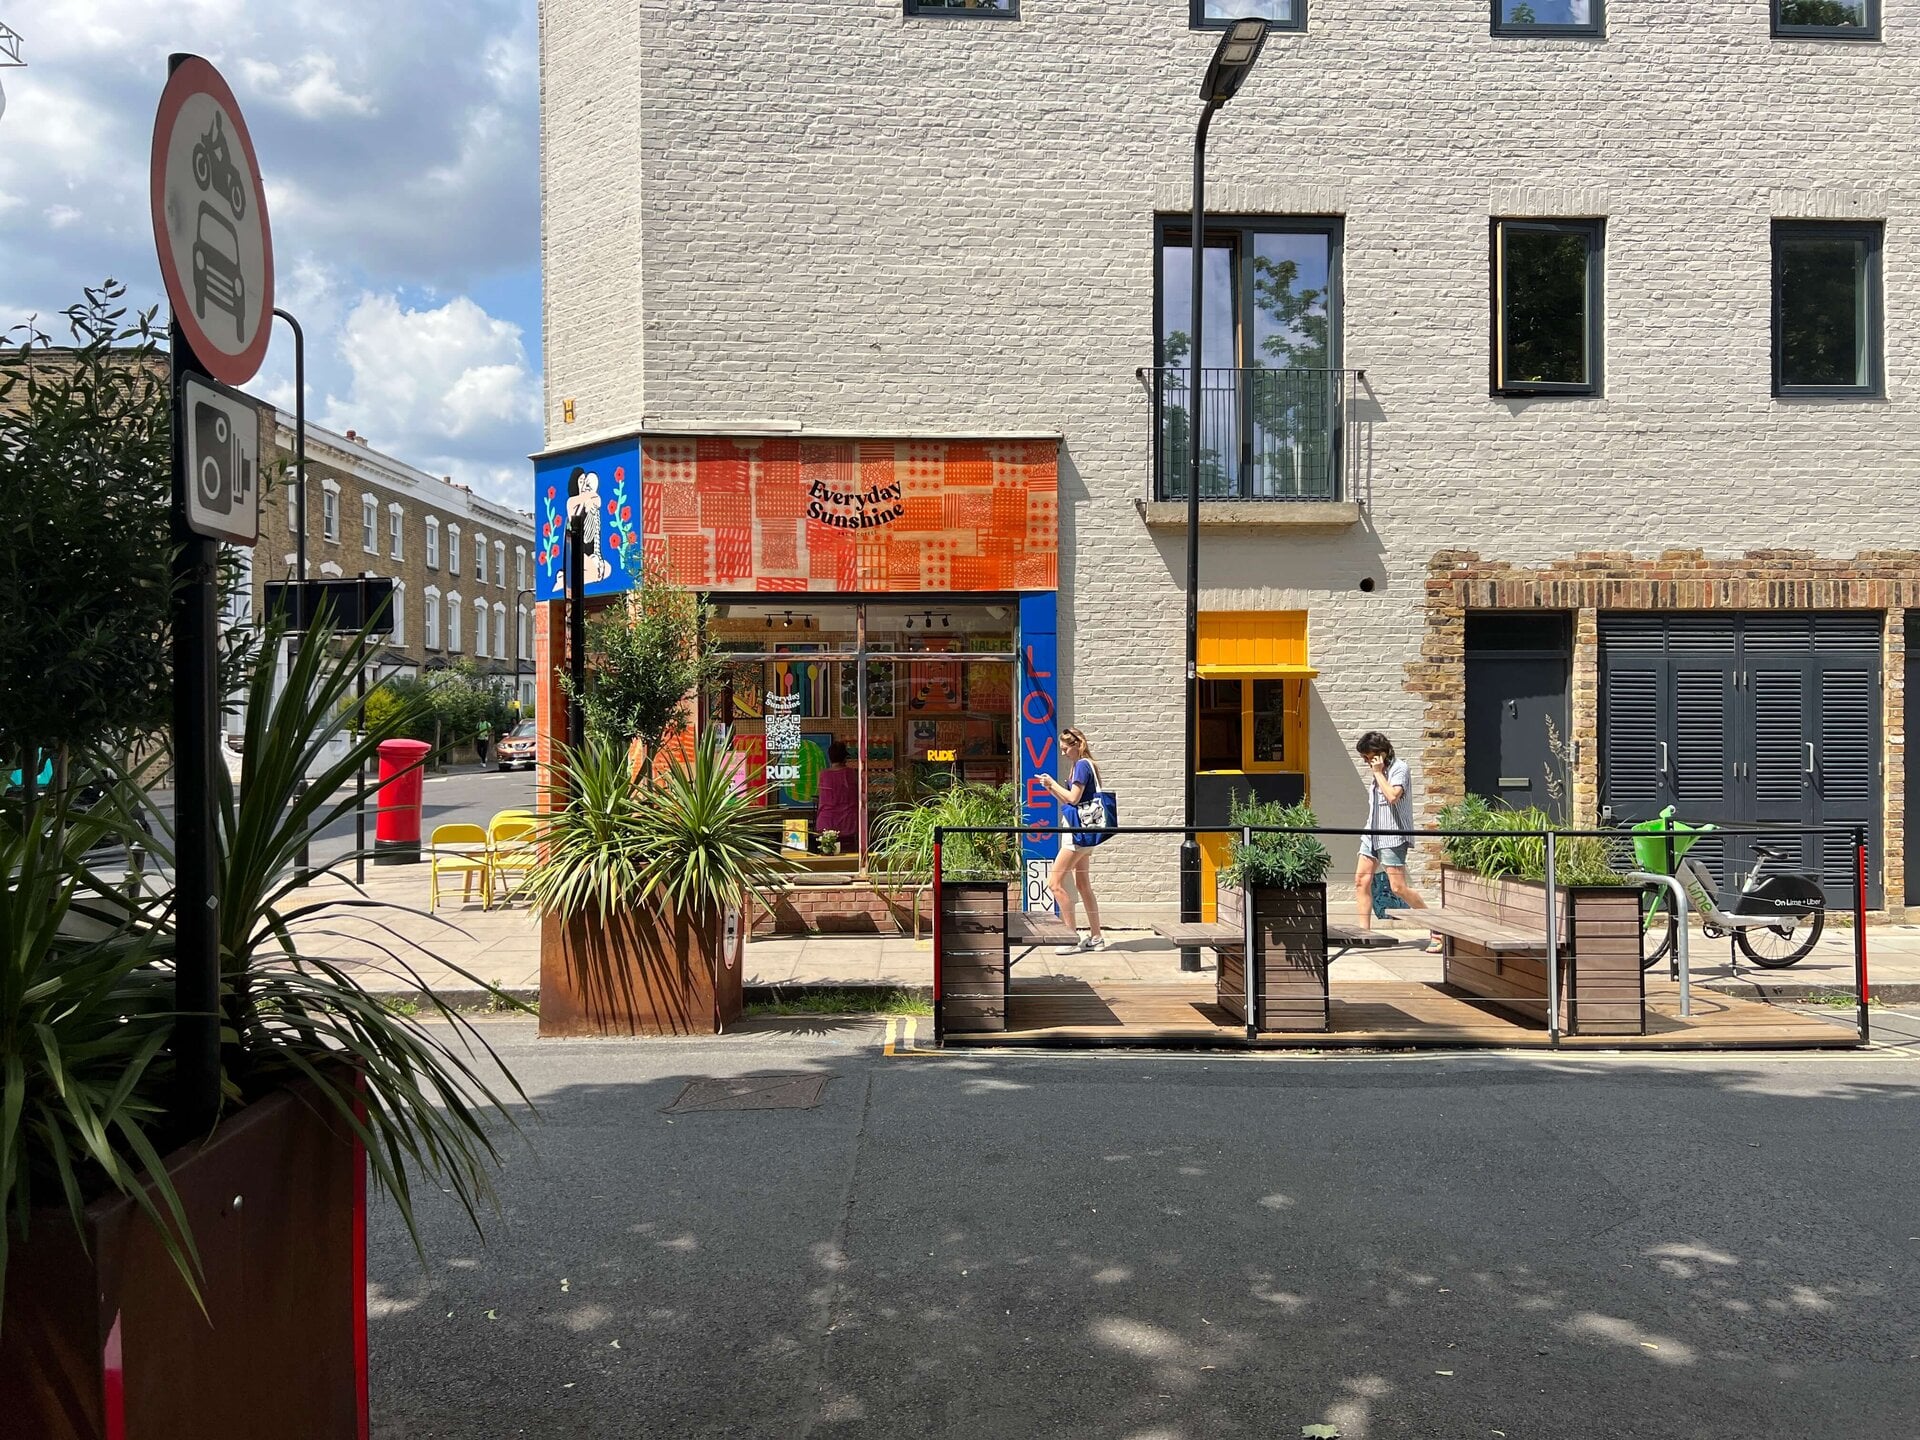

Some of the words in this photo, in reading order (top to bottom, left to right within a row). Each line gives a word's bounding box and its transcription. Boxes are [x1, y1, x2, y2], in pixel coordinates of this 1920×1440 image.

[809, 480, 902, 511] Everyday
[806, 501, 904, 529] Sunshine
[765, 699, 801, 709] Sunshine
[766, 691, 800, 702] Everyday
[1023, 645, 1054, 808] LOVE
[928, 750, 956, 761] RUDE
[766, 765, 801, 779] RUDE
[1028, 861, 1052, 879] ST
[1028, 880, 1053, 901] OK
[1687, 880, 1712, 912] Lime
[1786, 898, 1802, 906] Lime
